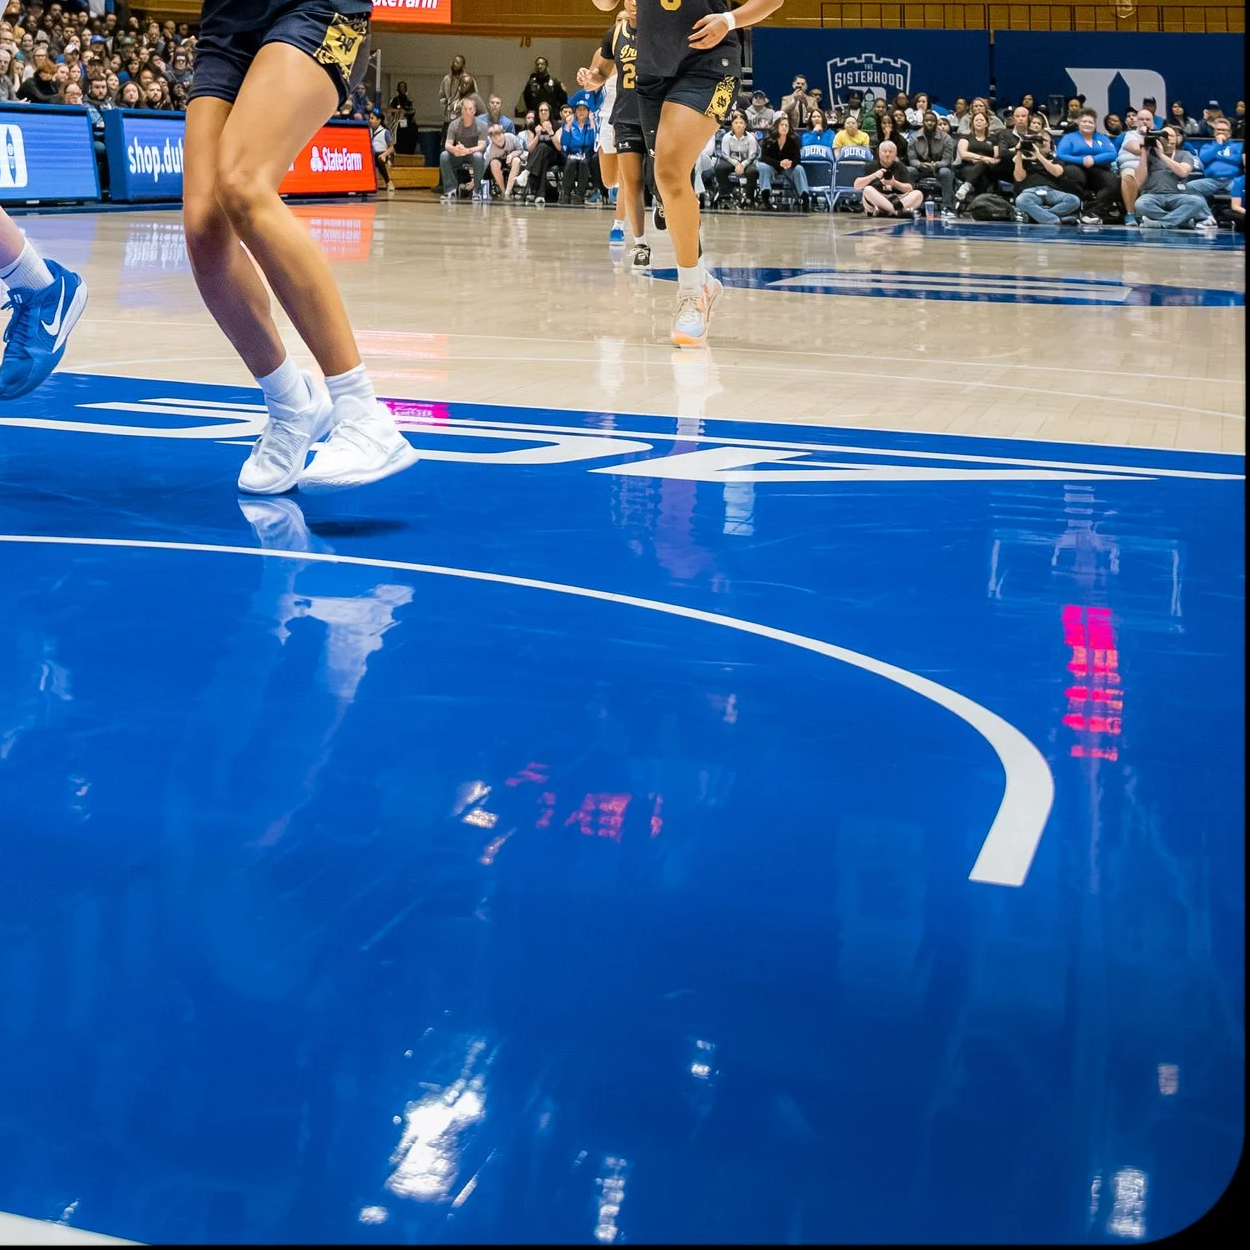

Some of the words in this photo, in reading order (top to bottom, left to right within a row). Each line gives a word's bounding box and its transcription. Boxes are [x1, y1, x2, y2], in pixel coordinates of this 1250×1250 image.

[834, 70, 904, 91] SISTERHOOD
[805, 146, 827, 157] DUKE
[844, 147, 866, 158] DUKE
